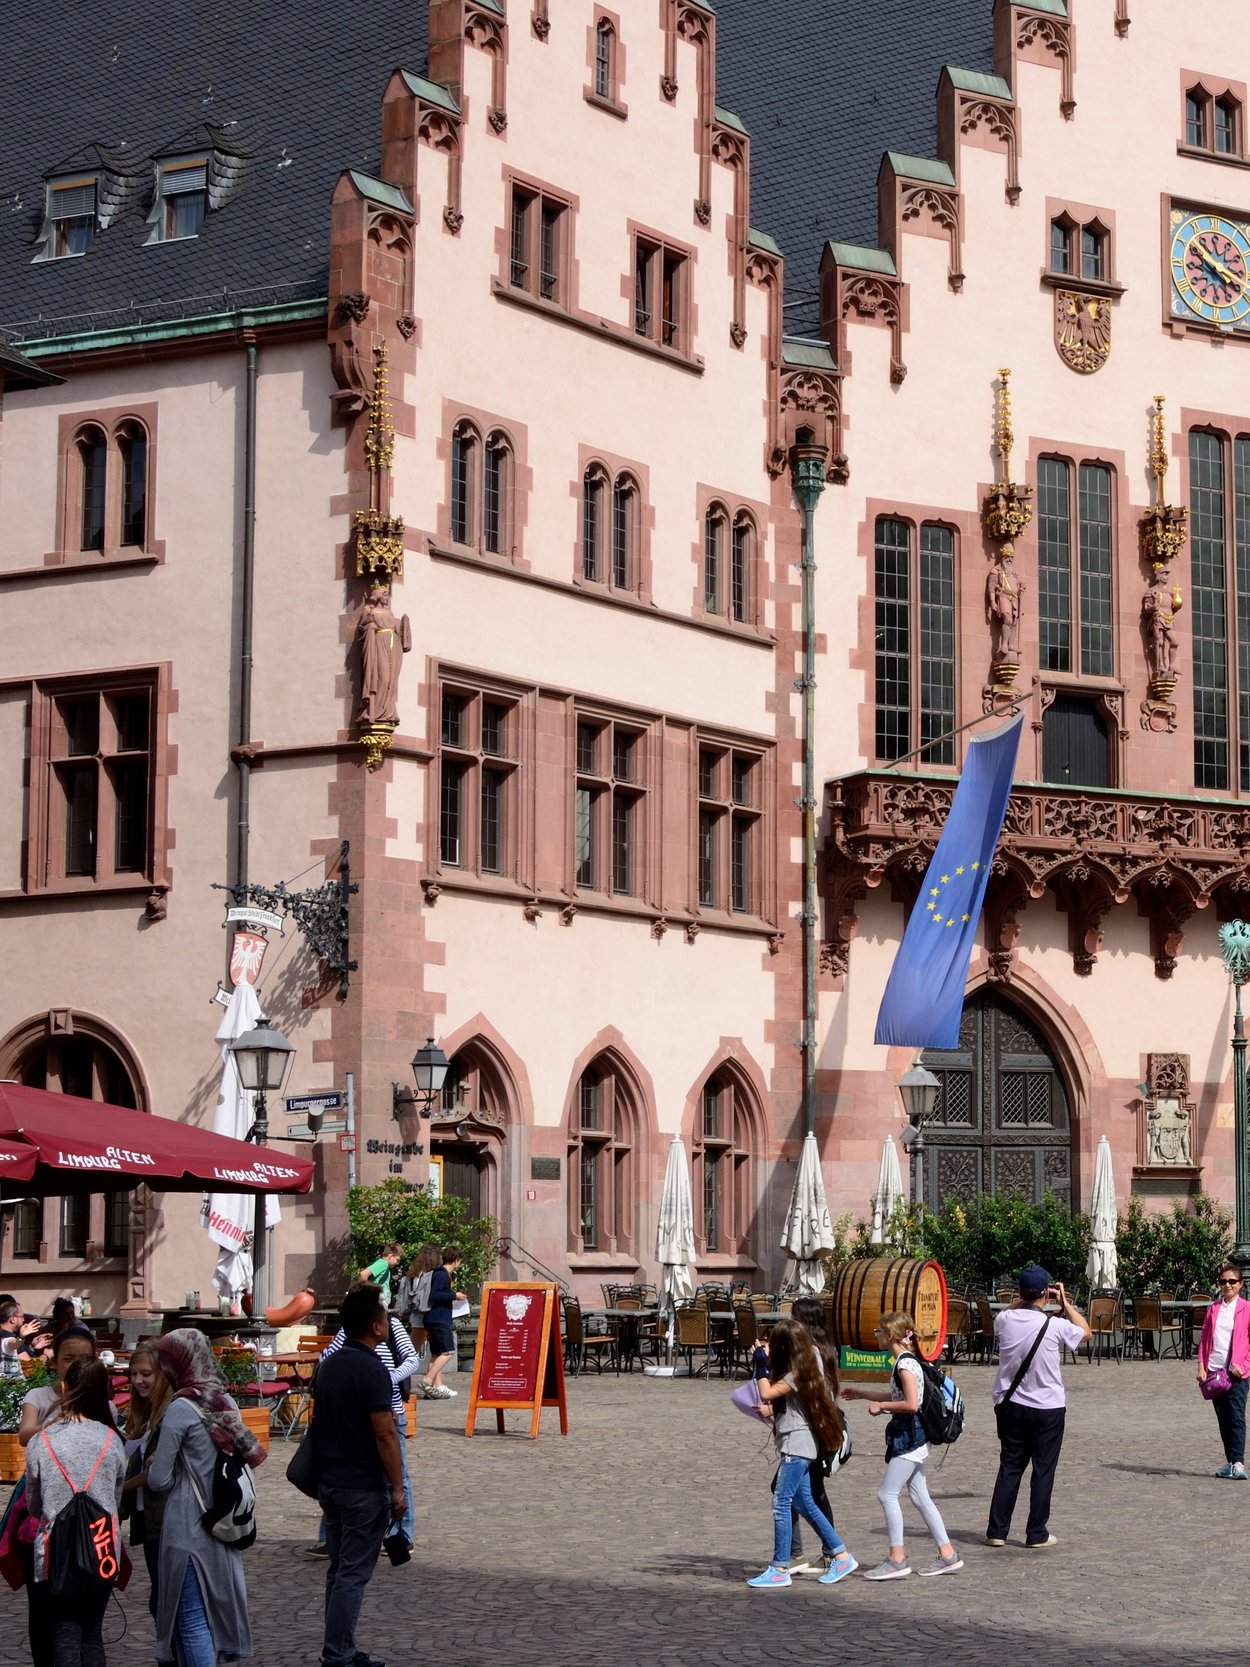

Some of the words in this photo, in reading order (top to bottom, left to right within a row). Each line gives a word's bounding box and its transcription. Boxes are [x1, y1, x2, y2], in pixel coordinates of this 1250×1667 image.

[106, 1146, 156, 1165] ALTEN
[253, 1162, 300, 1178] ALTEN
[388, 1159, 403, 1173] im
[528, 1191, 535, 1200] 19
[845, 1351, 887, 1363] WEINVERKAUF
[89, 1516, 117, 1579] NEO
